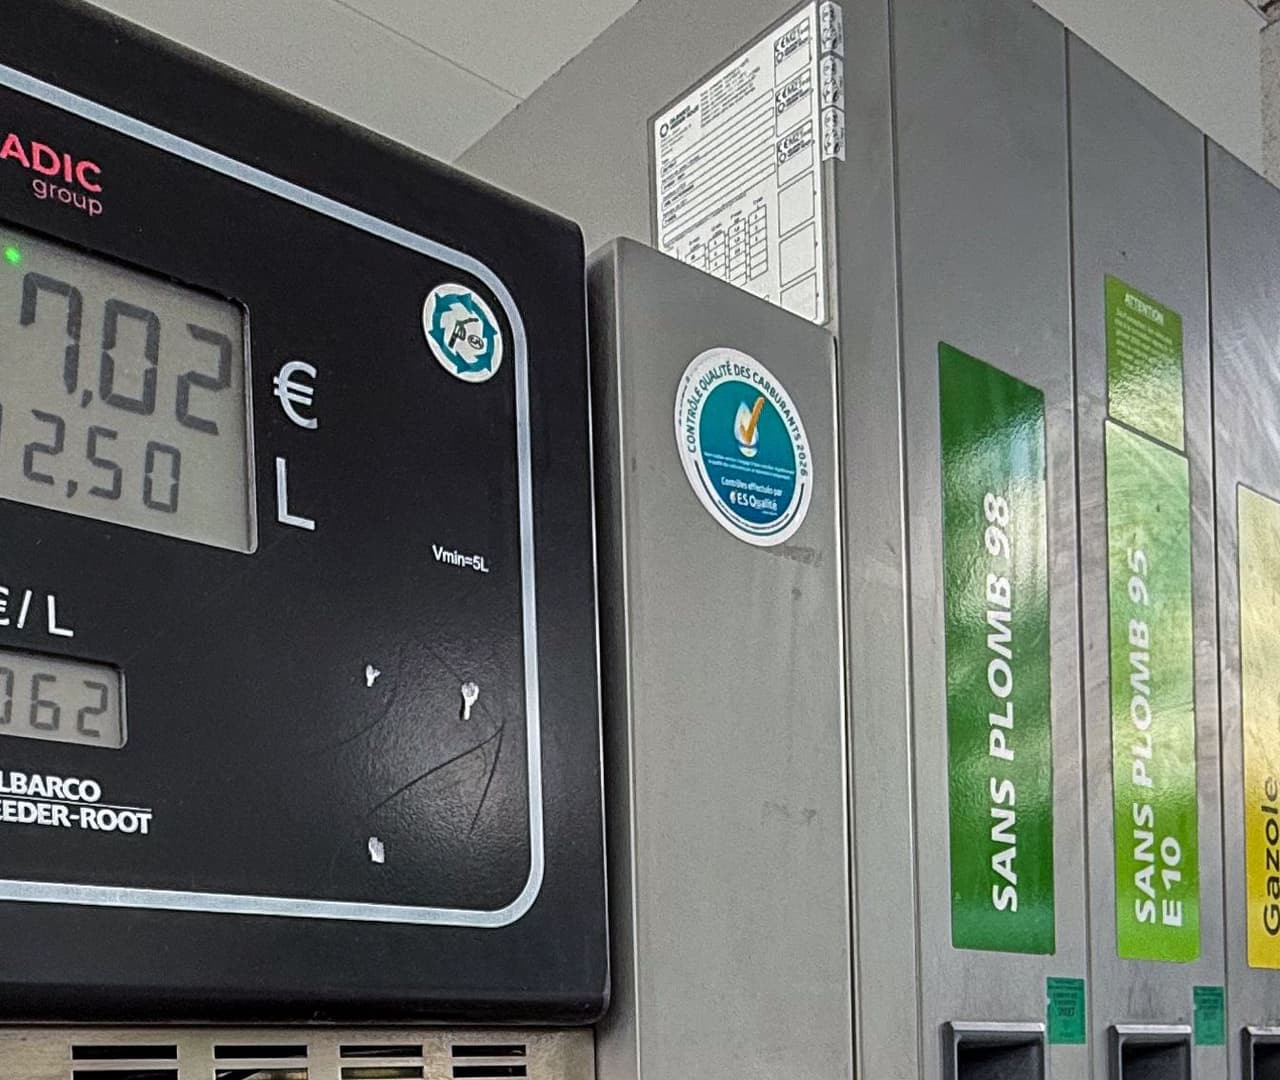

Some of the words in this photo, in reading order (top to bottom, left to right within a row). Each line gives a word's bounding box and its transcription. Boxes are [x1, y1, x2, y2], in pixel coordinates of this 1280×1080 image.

[31, 179, 104, 216] group
[272, 360, 319, 430] €
[685, 386, 704, 453] CONTRÔLE
[698, 360, 733, 392] QUALITÉ
[733, 363, 752, 380] DES
[752, 371, 802, 441] CARBURANTS
[796, 444, 809, 477] 2026
[275, 456, 316, 531] L
[983, 491, 1011, 560] 98
[431, 543, 490, 573] Vmin=5L
[1127, 548, 1150, 605] 95
[986, 574, 1015, 761] PLOMB
[1128, 621, 1154, 788] PLOMB
[990, 776, 1019, 913] SANS
[1133, 801, 1157, 926] SANS
[1160, 835, 1182, 892] 10
[1262, 780, 1280, 937] Gazole
[1162, 899, 1183, 928] E
